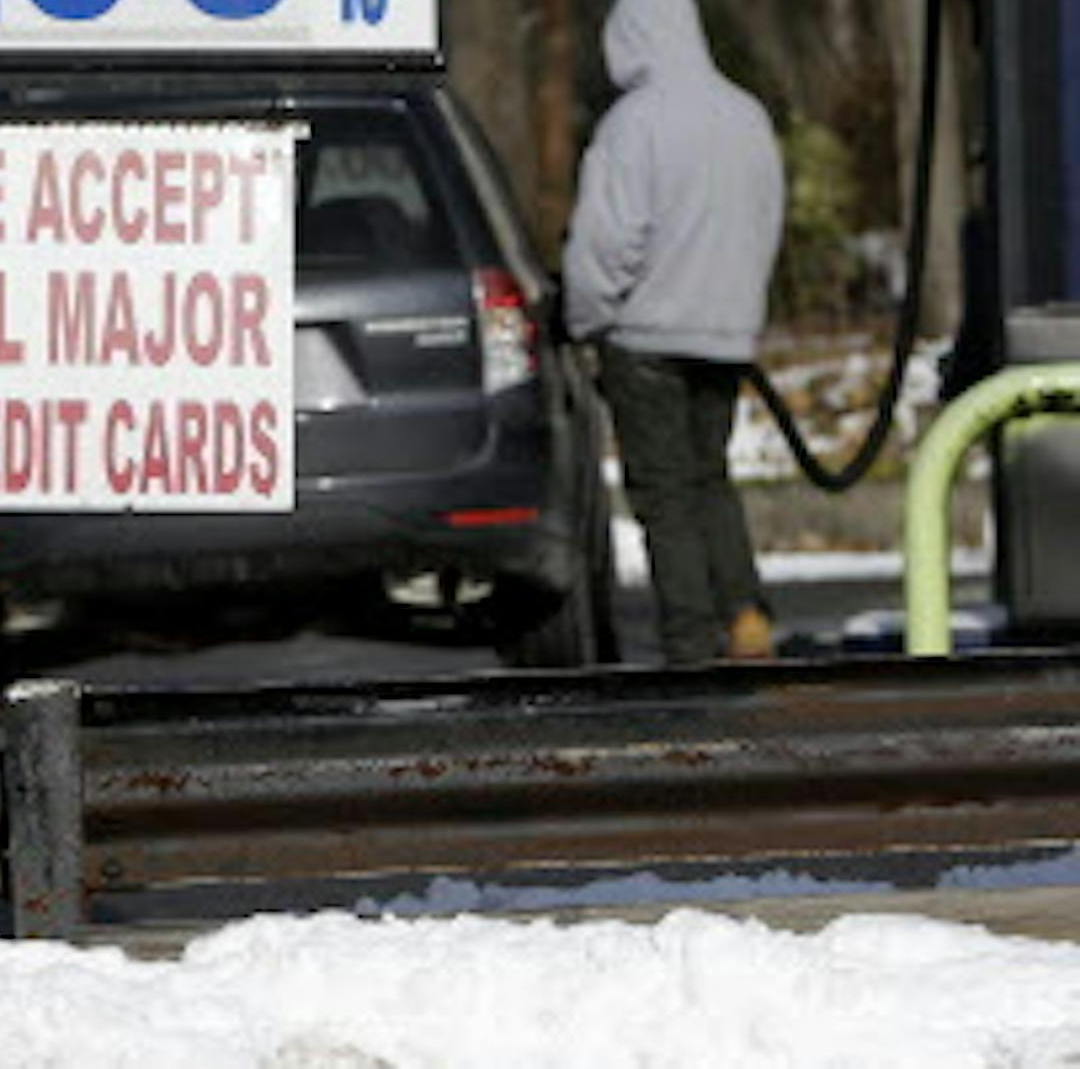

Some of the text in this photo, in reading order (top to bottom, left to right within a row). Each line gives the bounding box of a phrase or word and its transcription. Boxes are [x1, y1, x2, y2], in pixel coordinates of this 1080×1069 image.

[27, 149, 266, 245] ACCEPT
[47, 271, 271, 367] MAJOR
[104, 399, 280, 497] CARDS
